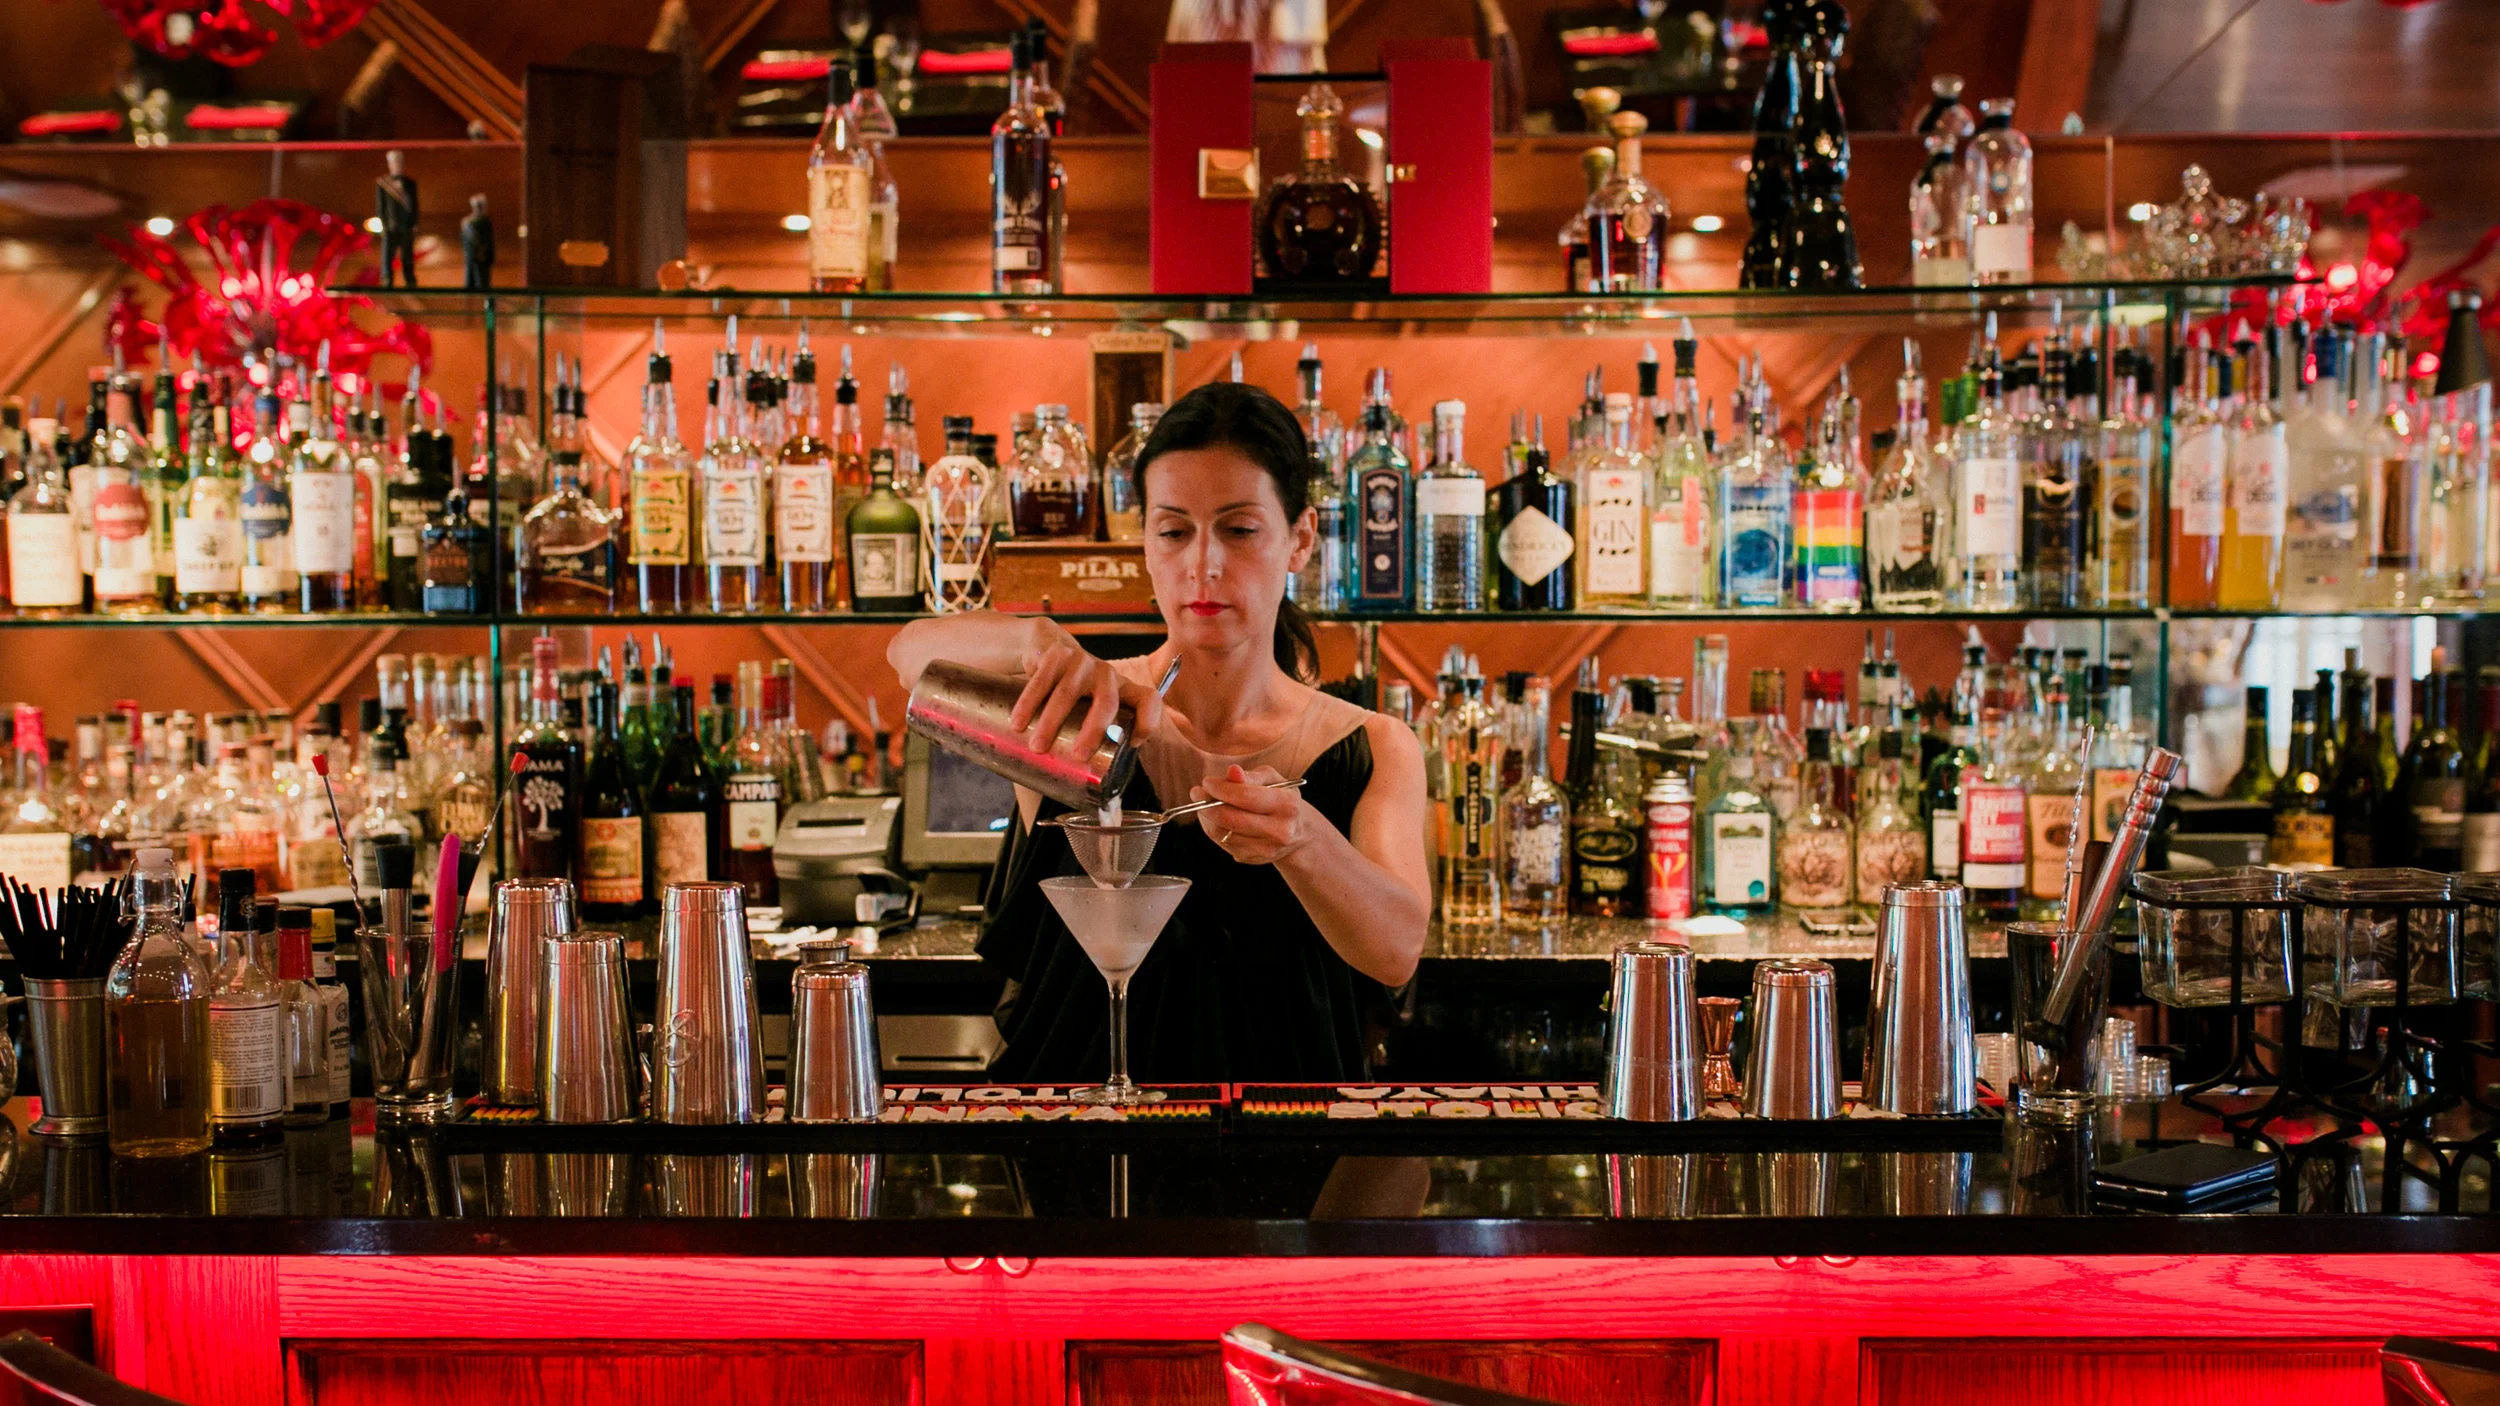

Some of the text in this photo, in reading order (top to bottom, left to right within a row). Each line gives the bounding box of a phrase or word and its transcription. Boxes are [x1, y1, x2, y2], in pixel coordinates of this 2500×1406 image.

[1593, 518, 1636, 543] GIN
[1060, 561, 1140, 578] PILAR
[520, 759, 565, 773] AMA
